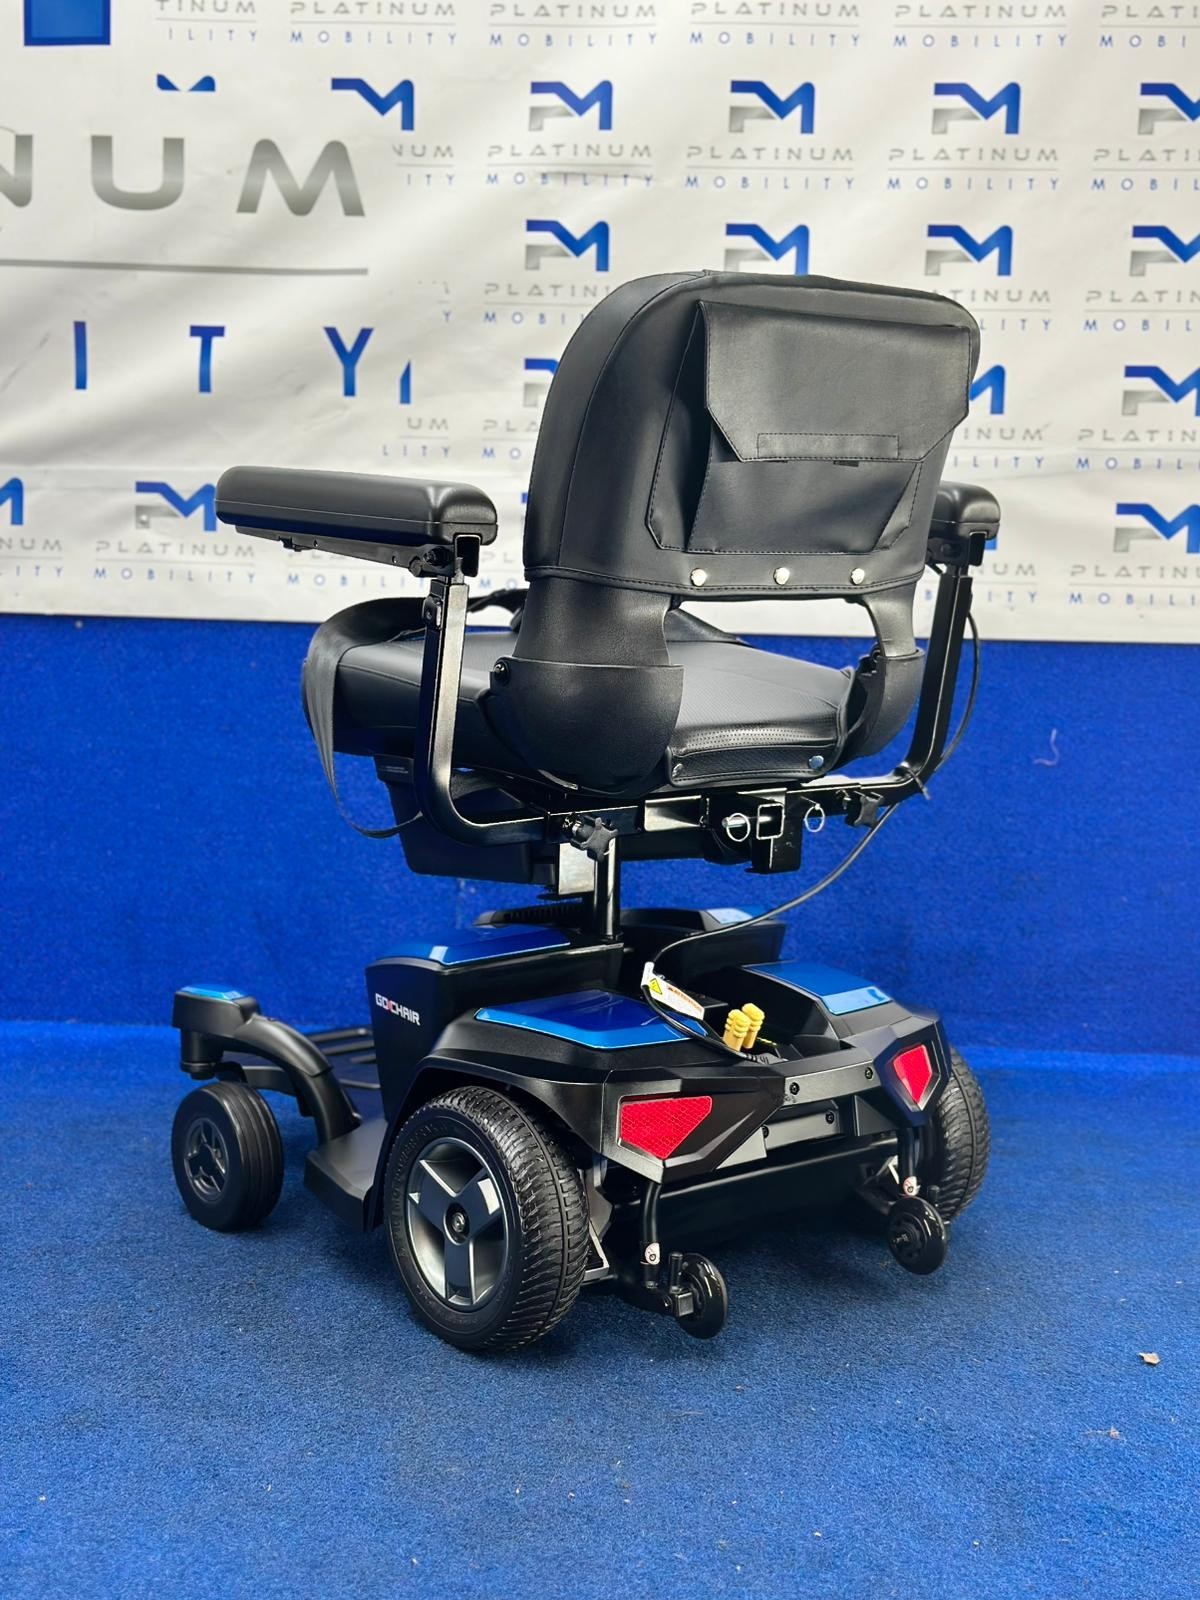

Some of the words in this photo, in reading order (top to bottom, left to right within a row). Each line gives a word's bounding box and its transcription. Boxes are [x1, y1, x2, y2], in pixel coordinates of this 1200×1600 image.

[290, 1, 455, 16] PLATINUM
[490, 3, 656, 18] PLATINUM
[691, 2, 859, 17] PLATINUM
[895, 4, 1066, 18] PLATINUM
[290, 30, 456, 45] MOBILITY
[489, 33, 656, 47] MOBILITY
[689, 31, 860, 46] MOBILITY
[893, 34, 1067, 48] MOBILITY
[488, 143, 652, 158] PLATINUM
[687, 145, 853, 161] PLATINUM
[888, 147, 1058, 162] PLATINUM
[1093, 148, 1200, 162] PLATI
[486, 170, 654, 187] MOBILITY
[684, 174, 854, 190] MOBILITY
[887, 176, 1059, 191] MOBILITY
[96, 538, 255, 557] PLATINUM
[93, 567, 255, 583] MOBILITY
